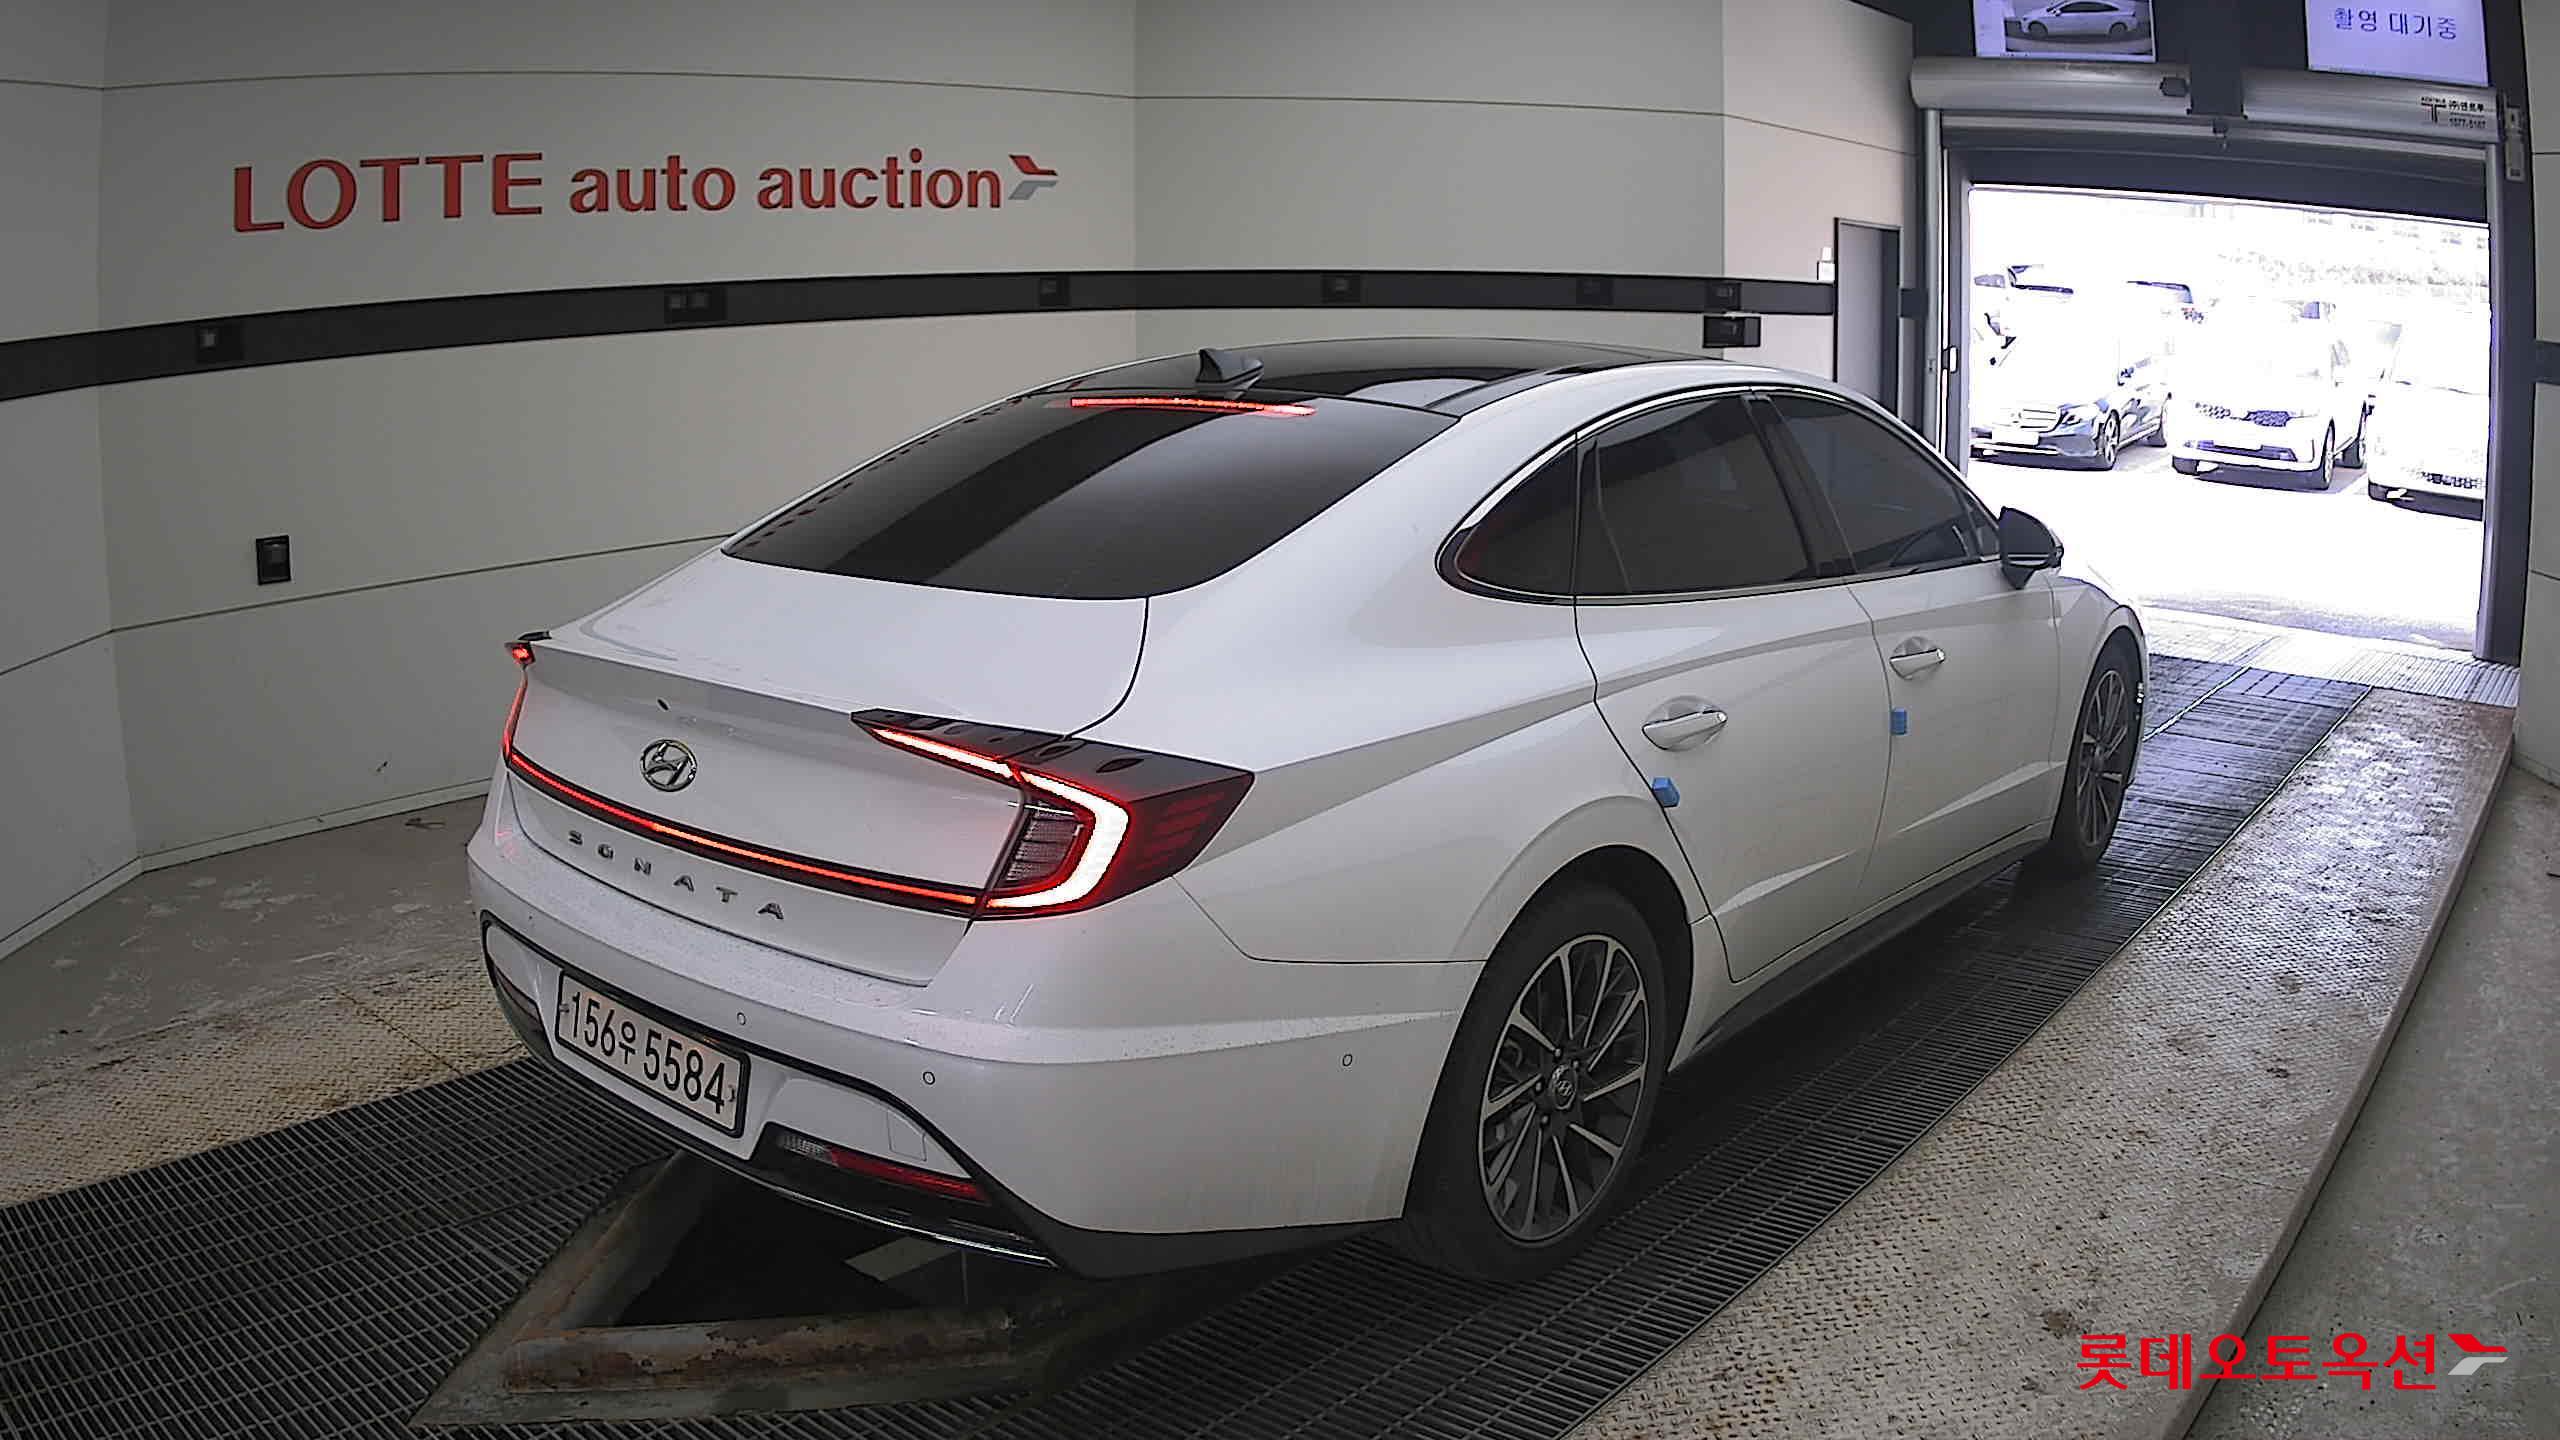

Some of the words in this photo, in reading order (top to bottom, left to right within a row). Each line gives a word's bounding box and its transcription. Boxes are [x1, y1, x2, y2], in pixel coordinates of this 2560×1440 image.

[2389, 13, 2457, 40] 대기중
[234, 152, 543, 233] LOTTE
[568, 154, 736, 213] auto
[757, 147, 1002, 210] auction
[568, 829, 785, 921] SONATA
